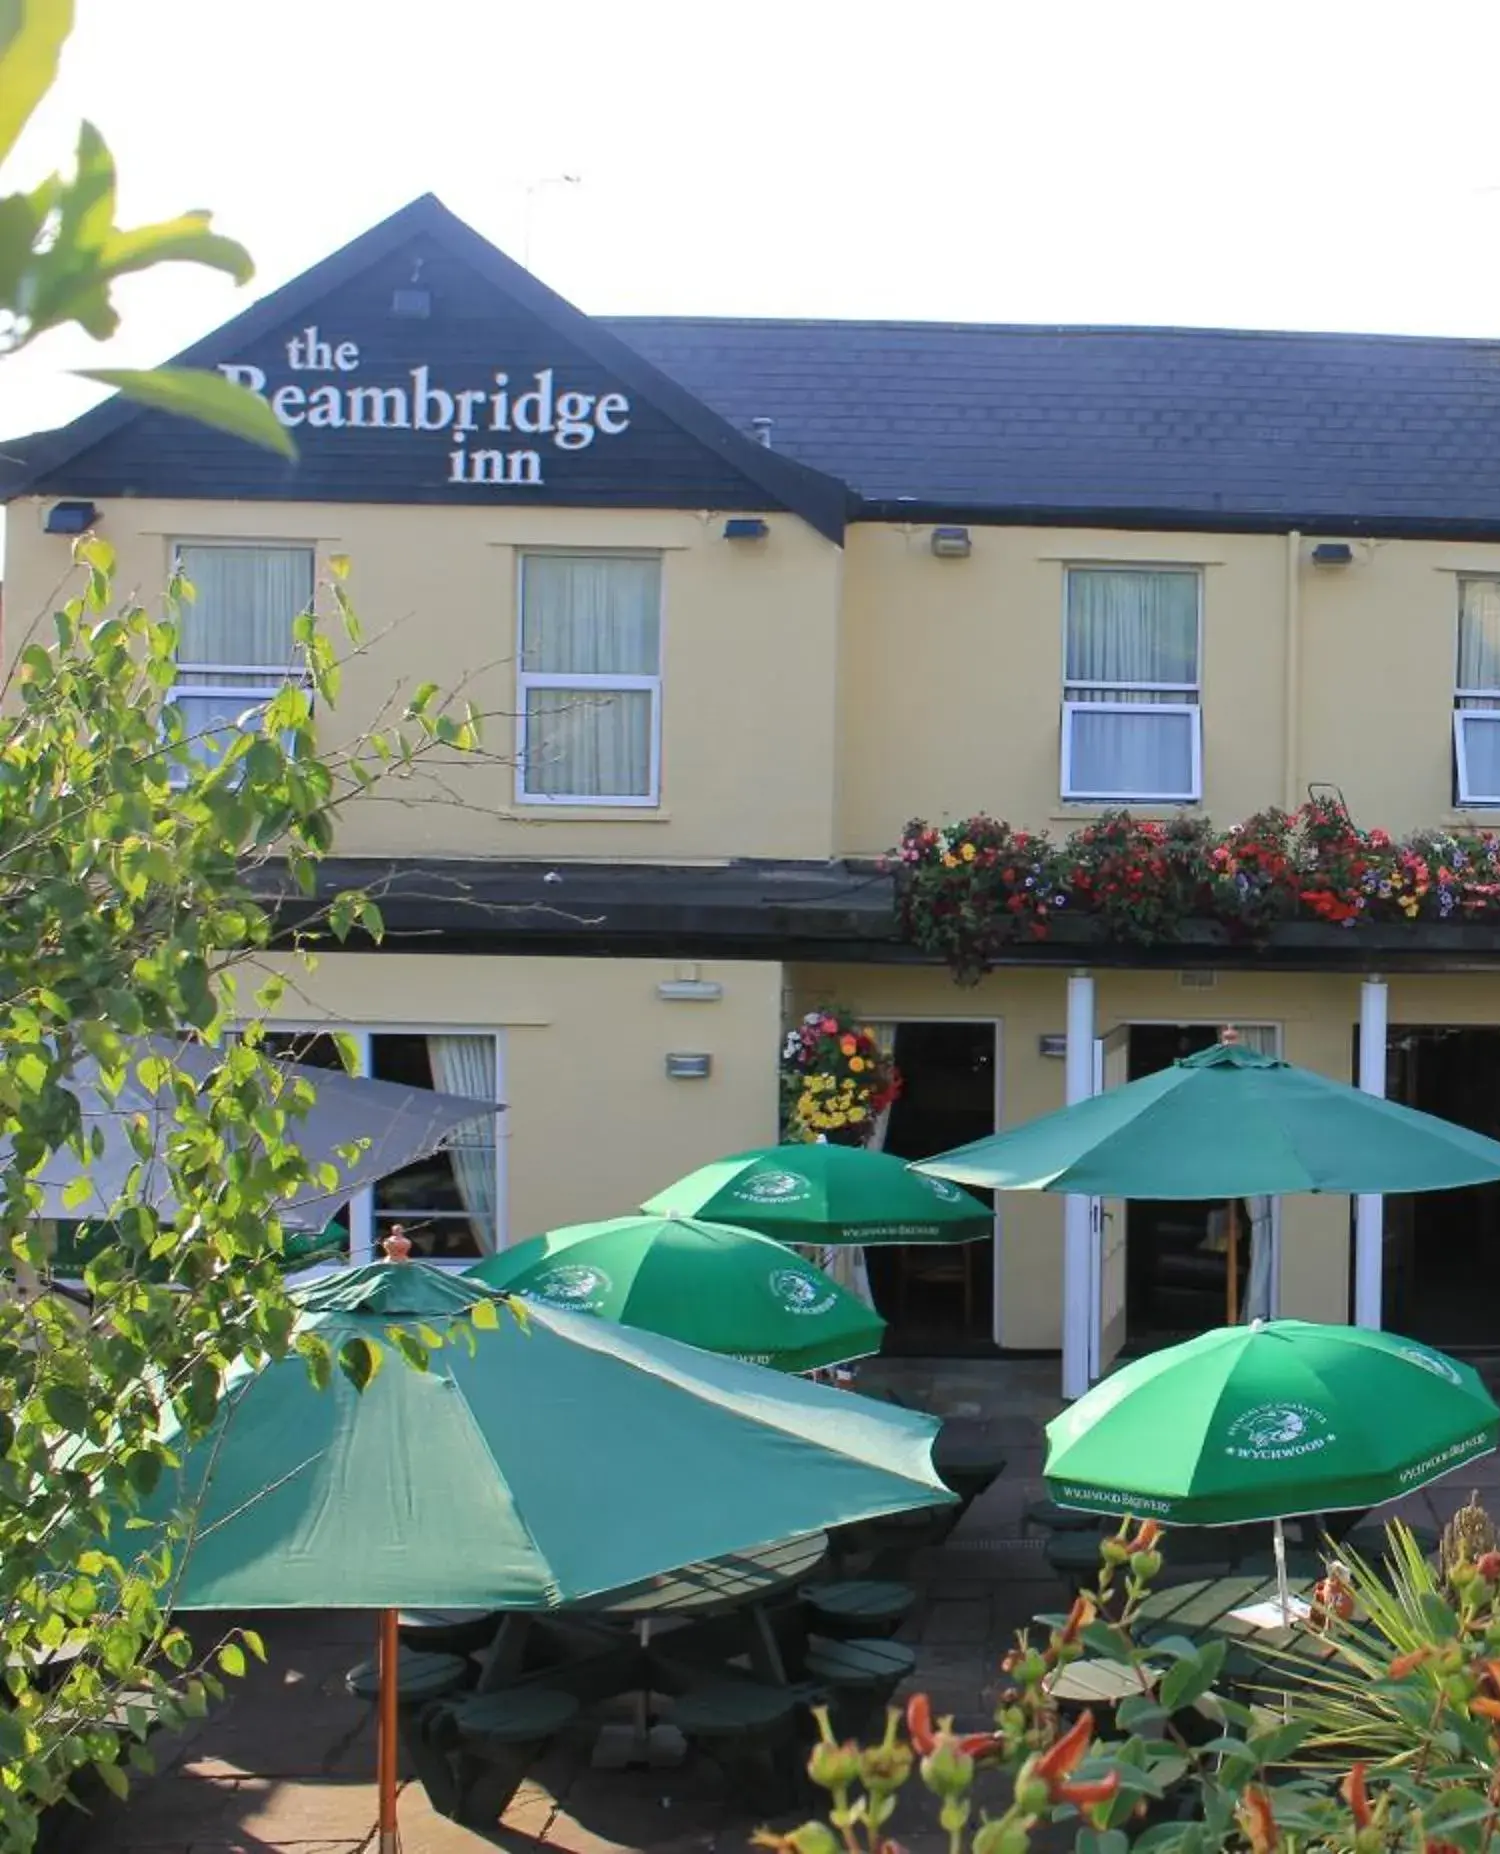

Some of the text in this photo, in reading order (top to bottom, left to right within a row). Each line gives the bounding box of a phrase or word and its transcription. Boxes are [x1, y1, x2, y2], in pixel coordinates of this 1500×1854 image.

[287, 326, 360, 371] the
[448, 432, 544, 485] inn
[1237, 1437, 1325, 1460] WYCHWOOD
